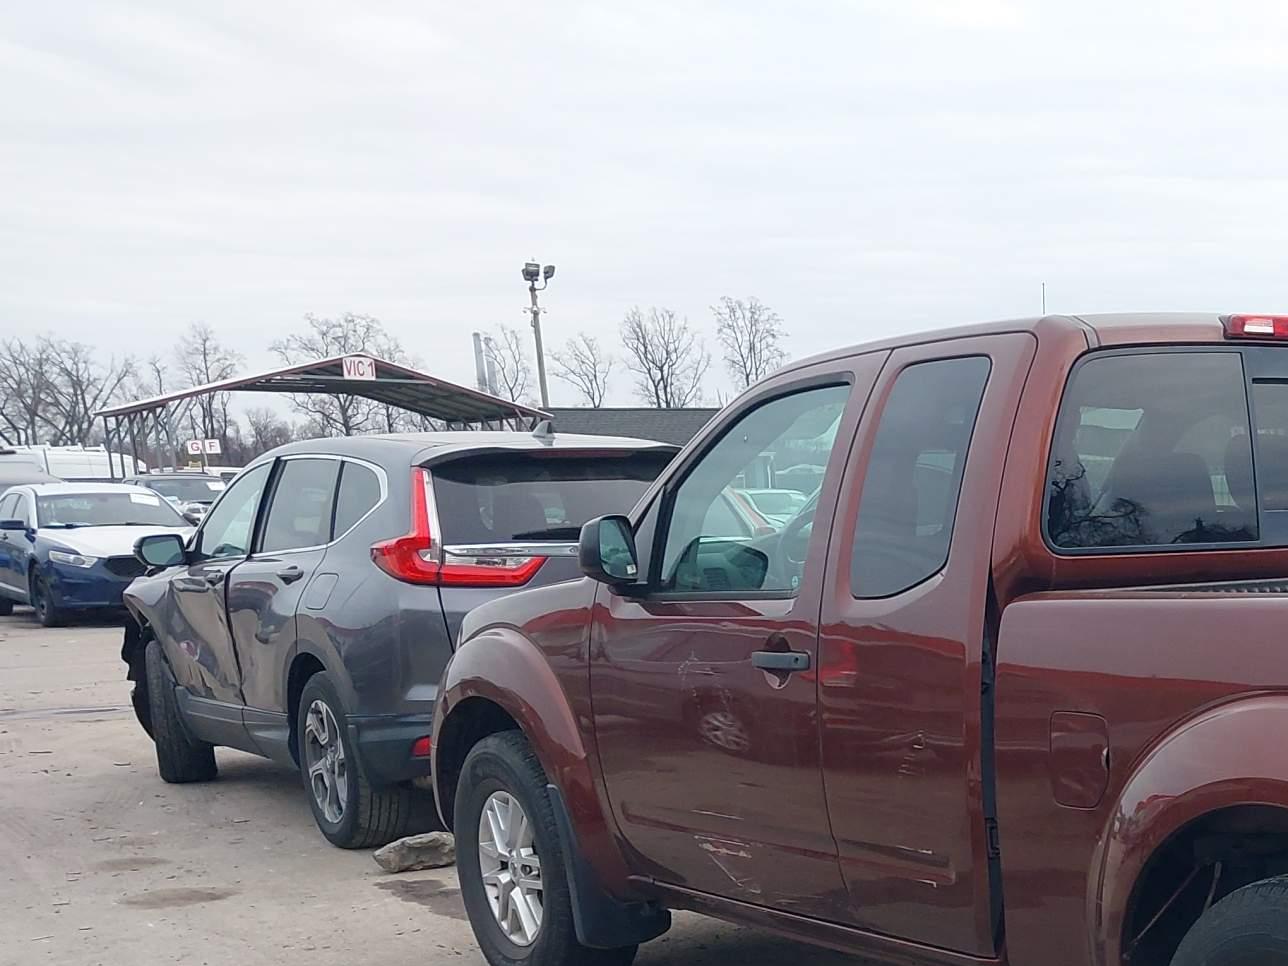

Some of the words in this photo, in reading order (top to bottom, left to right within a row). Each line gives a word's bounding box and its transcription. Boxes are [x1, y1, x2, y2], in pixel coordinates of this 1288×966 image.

[344, 360, 365, 376] VIC
[367, 361, 374, 376] 1
[190, 441, 200, 452] G
[208, 441, 216, 452] F
